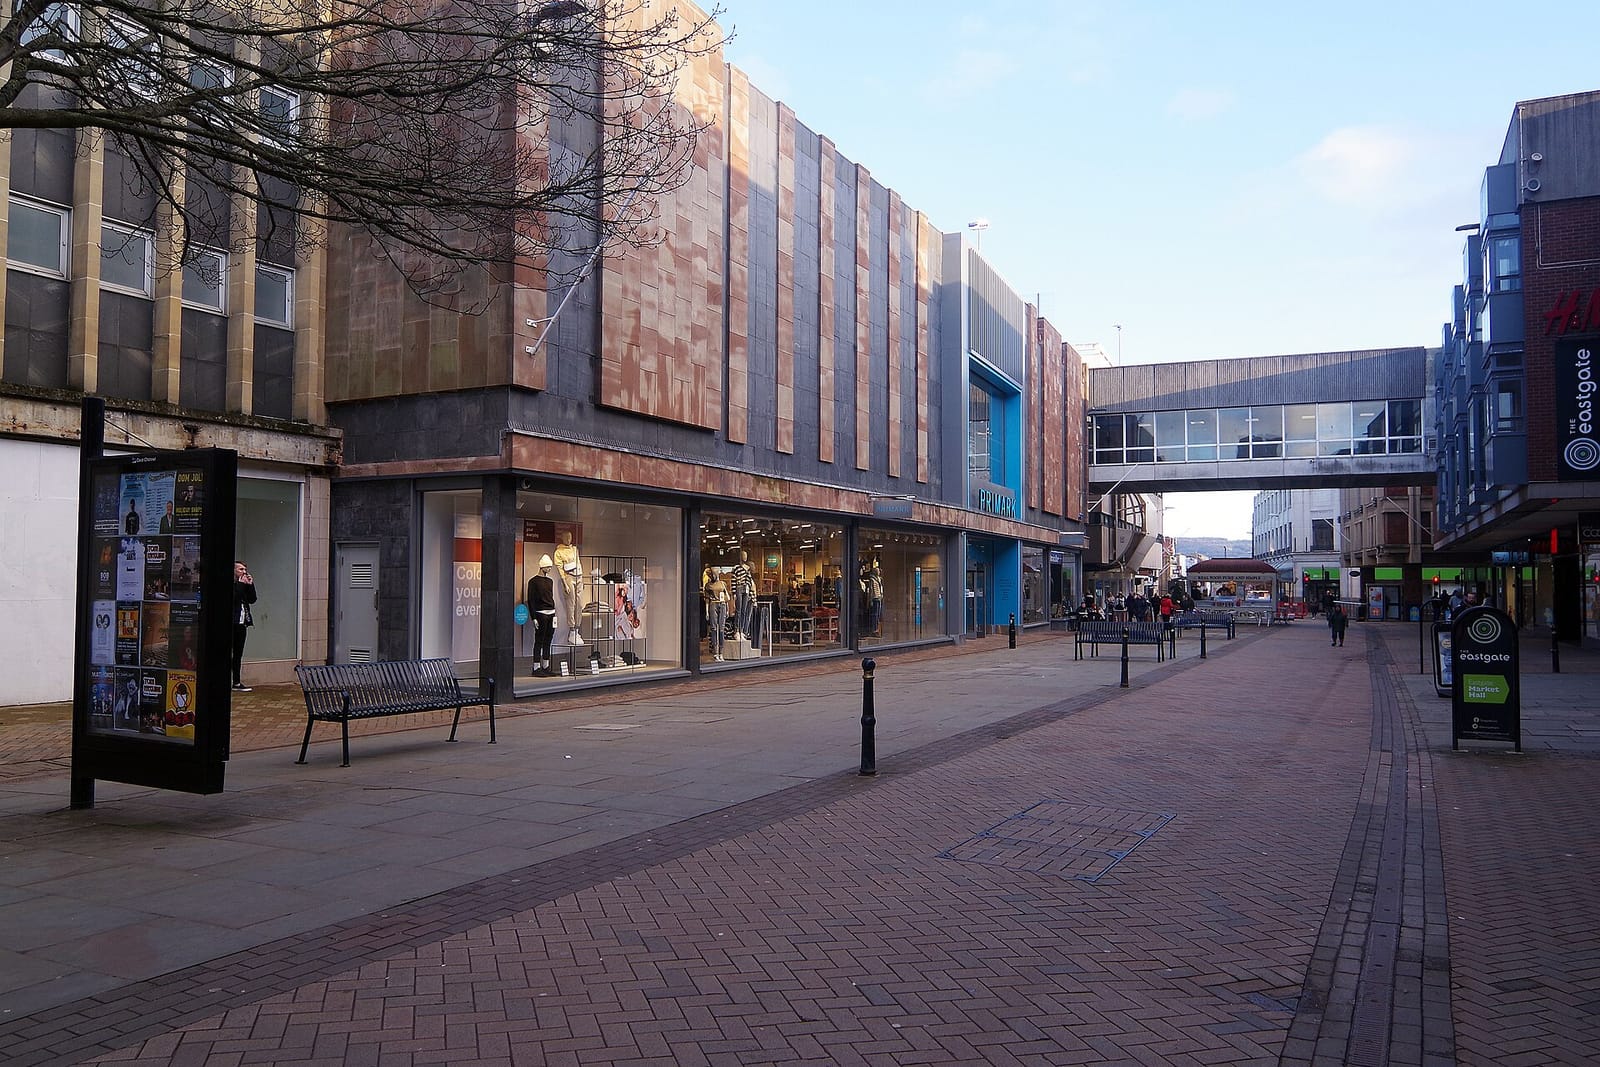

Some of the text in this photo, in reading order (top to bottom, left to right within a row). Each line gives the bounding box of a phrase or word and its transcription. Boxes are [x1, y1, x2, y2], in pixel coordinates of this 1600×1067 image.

[1575, 348, 1598, 434] eastgate
[978, 489, 1017, 518] PRIMARK
[1460, 653, 1510, 664] eastgate
